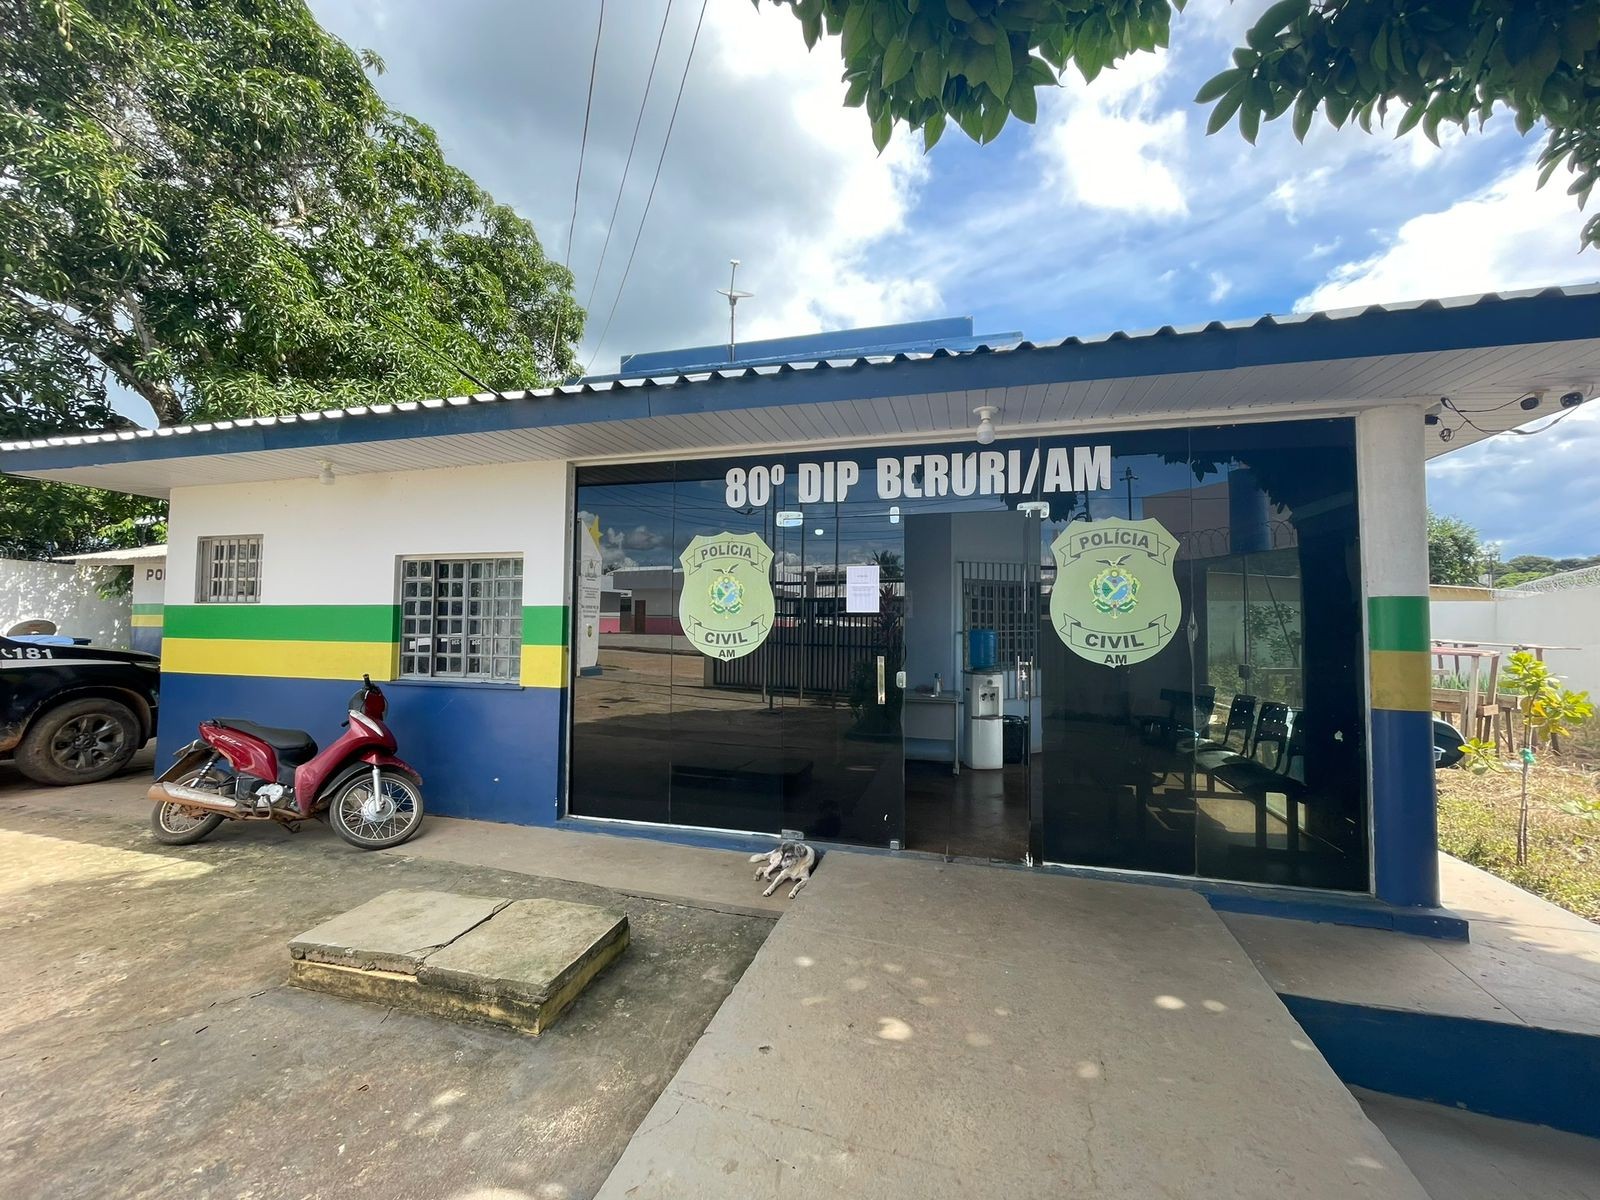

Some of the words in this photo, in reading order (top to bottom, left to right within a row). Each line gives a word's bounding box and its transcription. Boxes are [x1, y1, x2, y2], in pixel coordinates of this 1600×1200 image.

[798, 460, 859, 503] DIP
[876, 445, 1112, 499] BERURI/AM
[1079, 528, 1150, 550] POLÍCIA
[700, 541, 752, 561] POLÍCIA
[704, 631, 748, 645] CIVIL
[1085, 632, 1144, 649] CIVIL
[13, 647, 53, 660] 181
[718, 649, 736, 658] AM
[1104, 654, 1127, 665] AM
